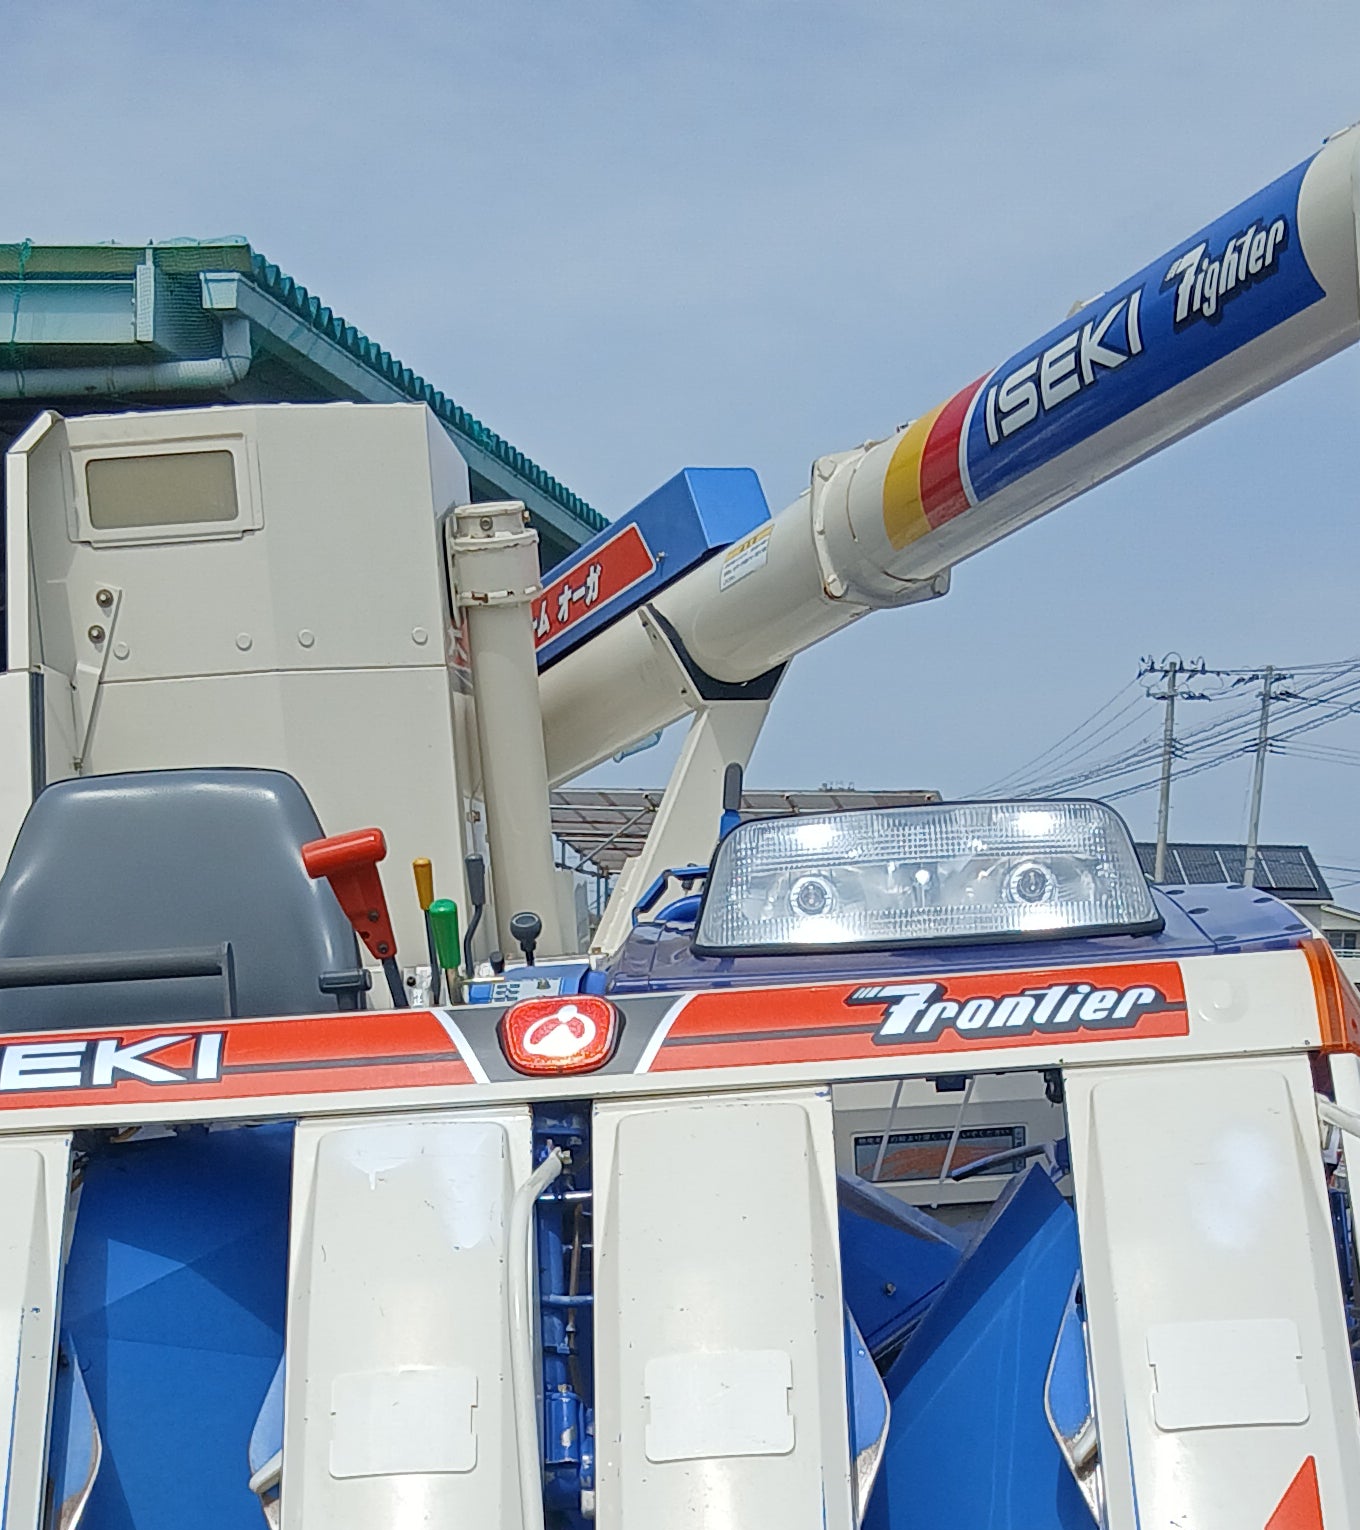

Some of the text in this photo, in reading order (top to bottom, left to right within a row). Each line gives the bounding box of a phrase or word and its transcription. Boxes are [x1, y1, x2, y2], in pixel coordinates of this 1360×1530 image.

[986, 219, 1286, 446] ISEKI Fighter
[557, 563, 602, 623] オーガ
[851, 982, 1156, 1036] Frontier
